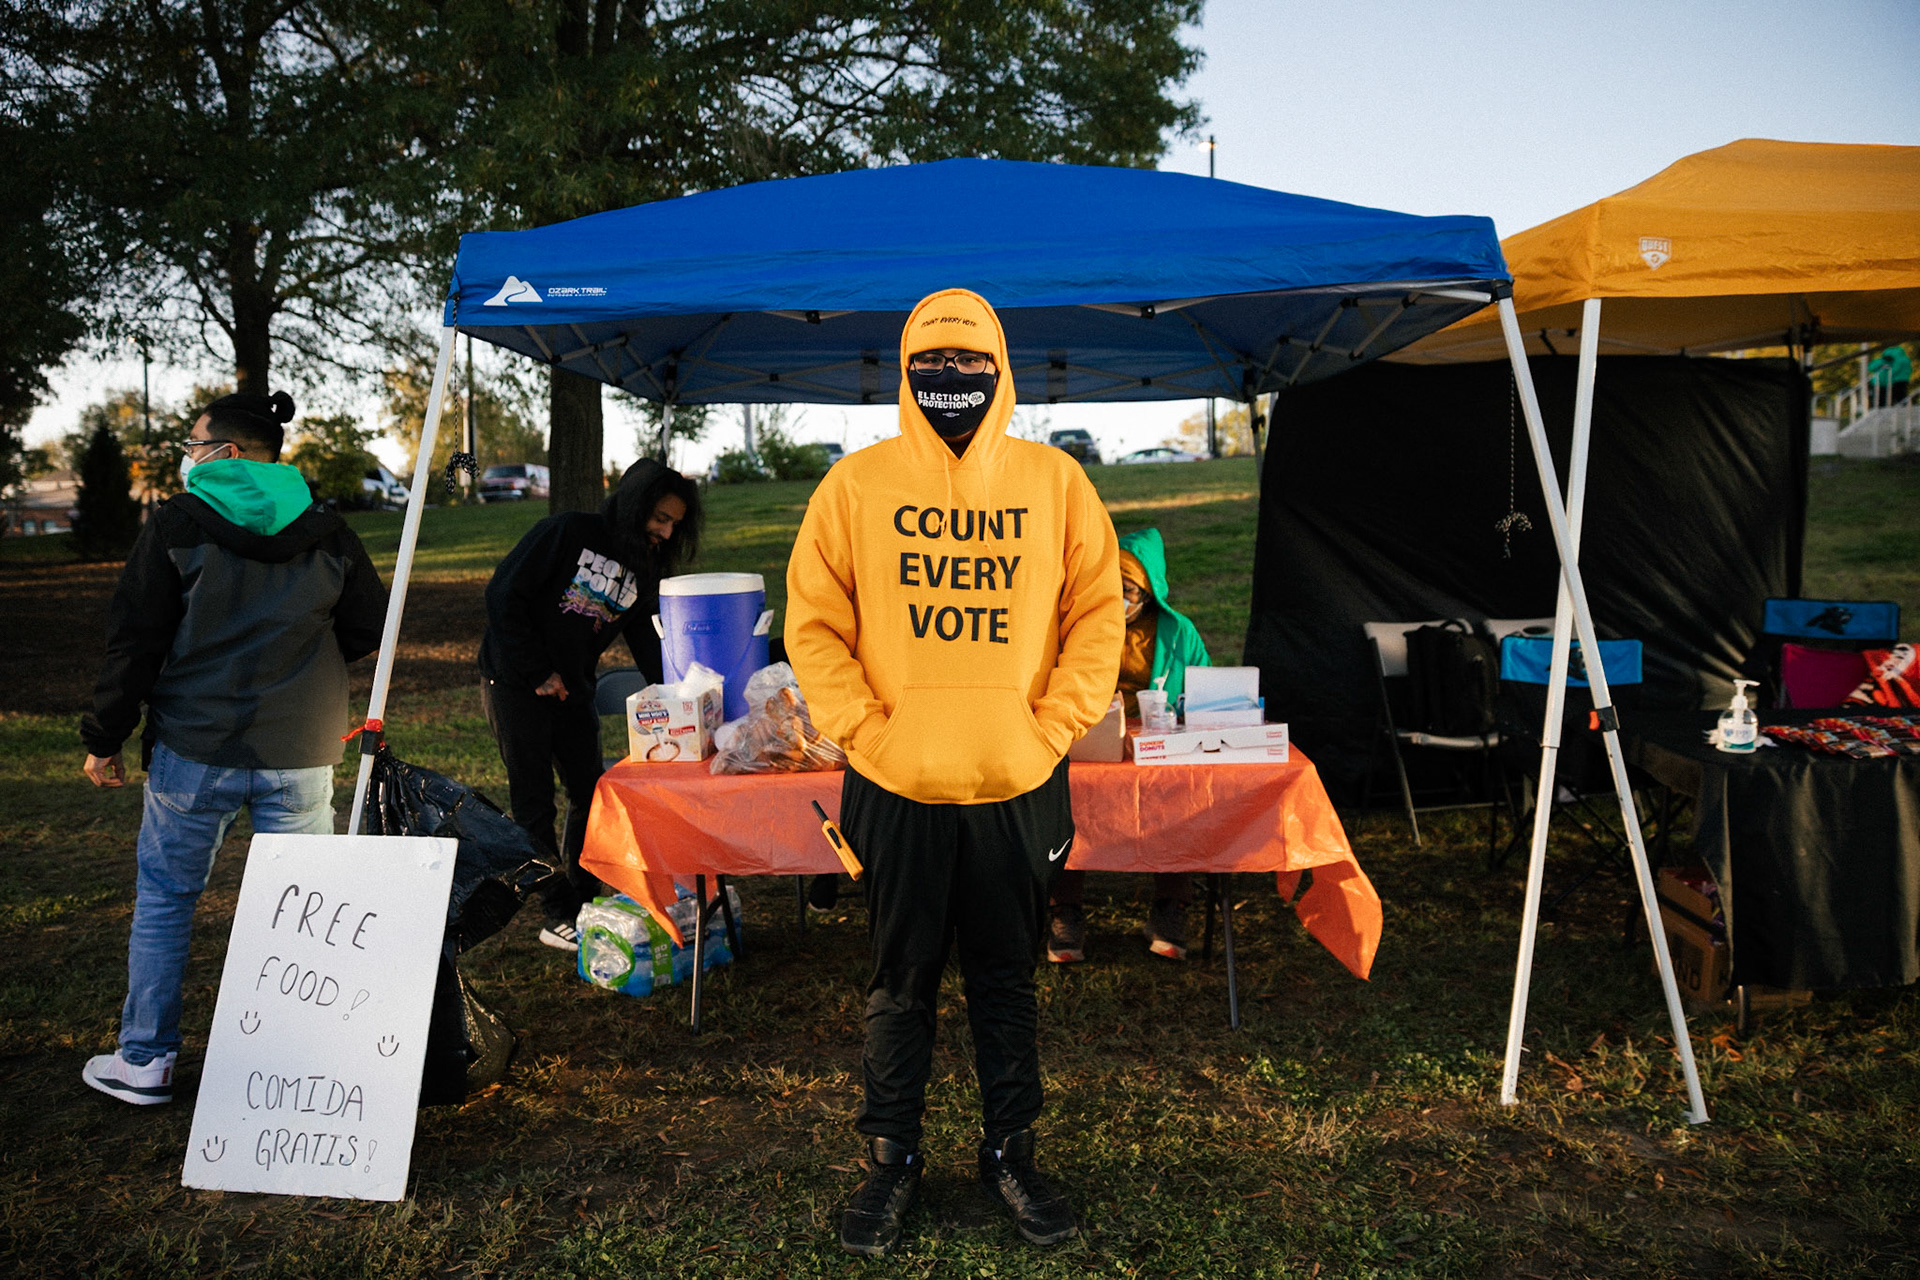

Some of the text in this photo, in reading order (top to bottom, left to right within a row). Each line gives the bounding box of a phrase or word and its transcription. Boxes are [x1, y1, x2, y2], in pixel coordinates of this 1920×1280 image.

[917, 391, 969, 401] ELECTION
[918, 399, 969, 409] PROTECTION
[894, 505, 1028, 541] COUNT
[900, 552, 1022, 591] EVERY
[908, 603, 1009, 644] VOTE
[271, 884, 377, 950] FREE
[247, 1071, 363, 1122] COMIDA
[255, 1128, 378, 1174] GRATIS!
